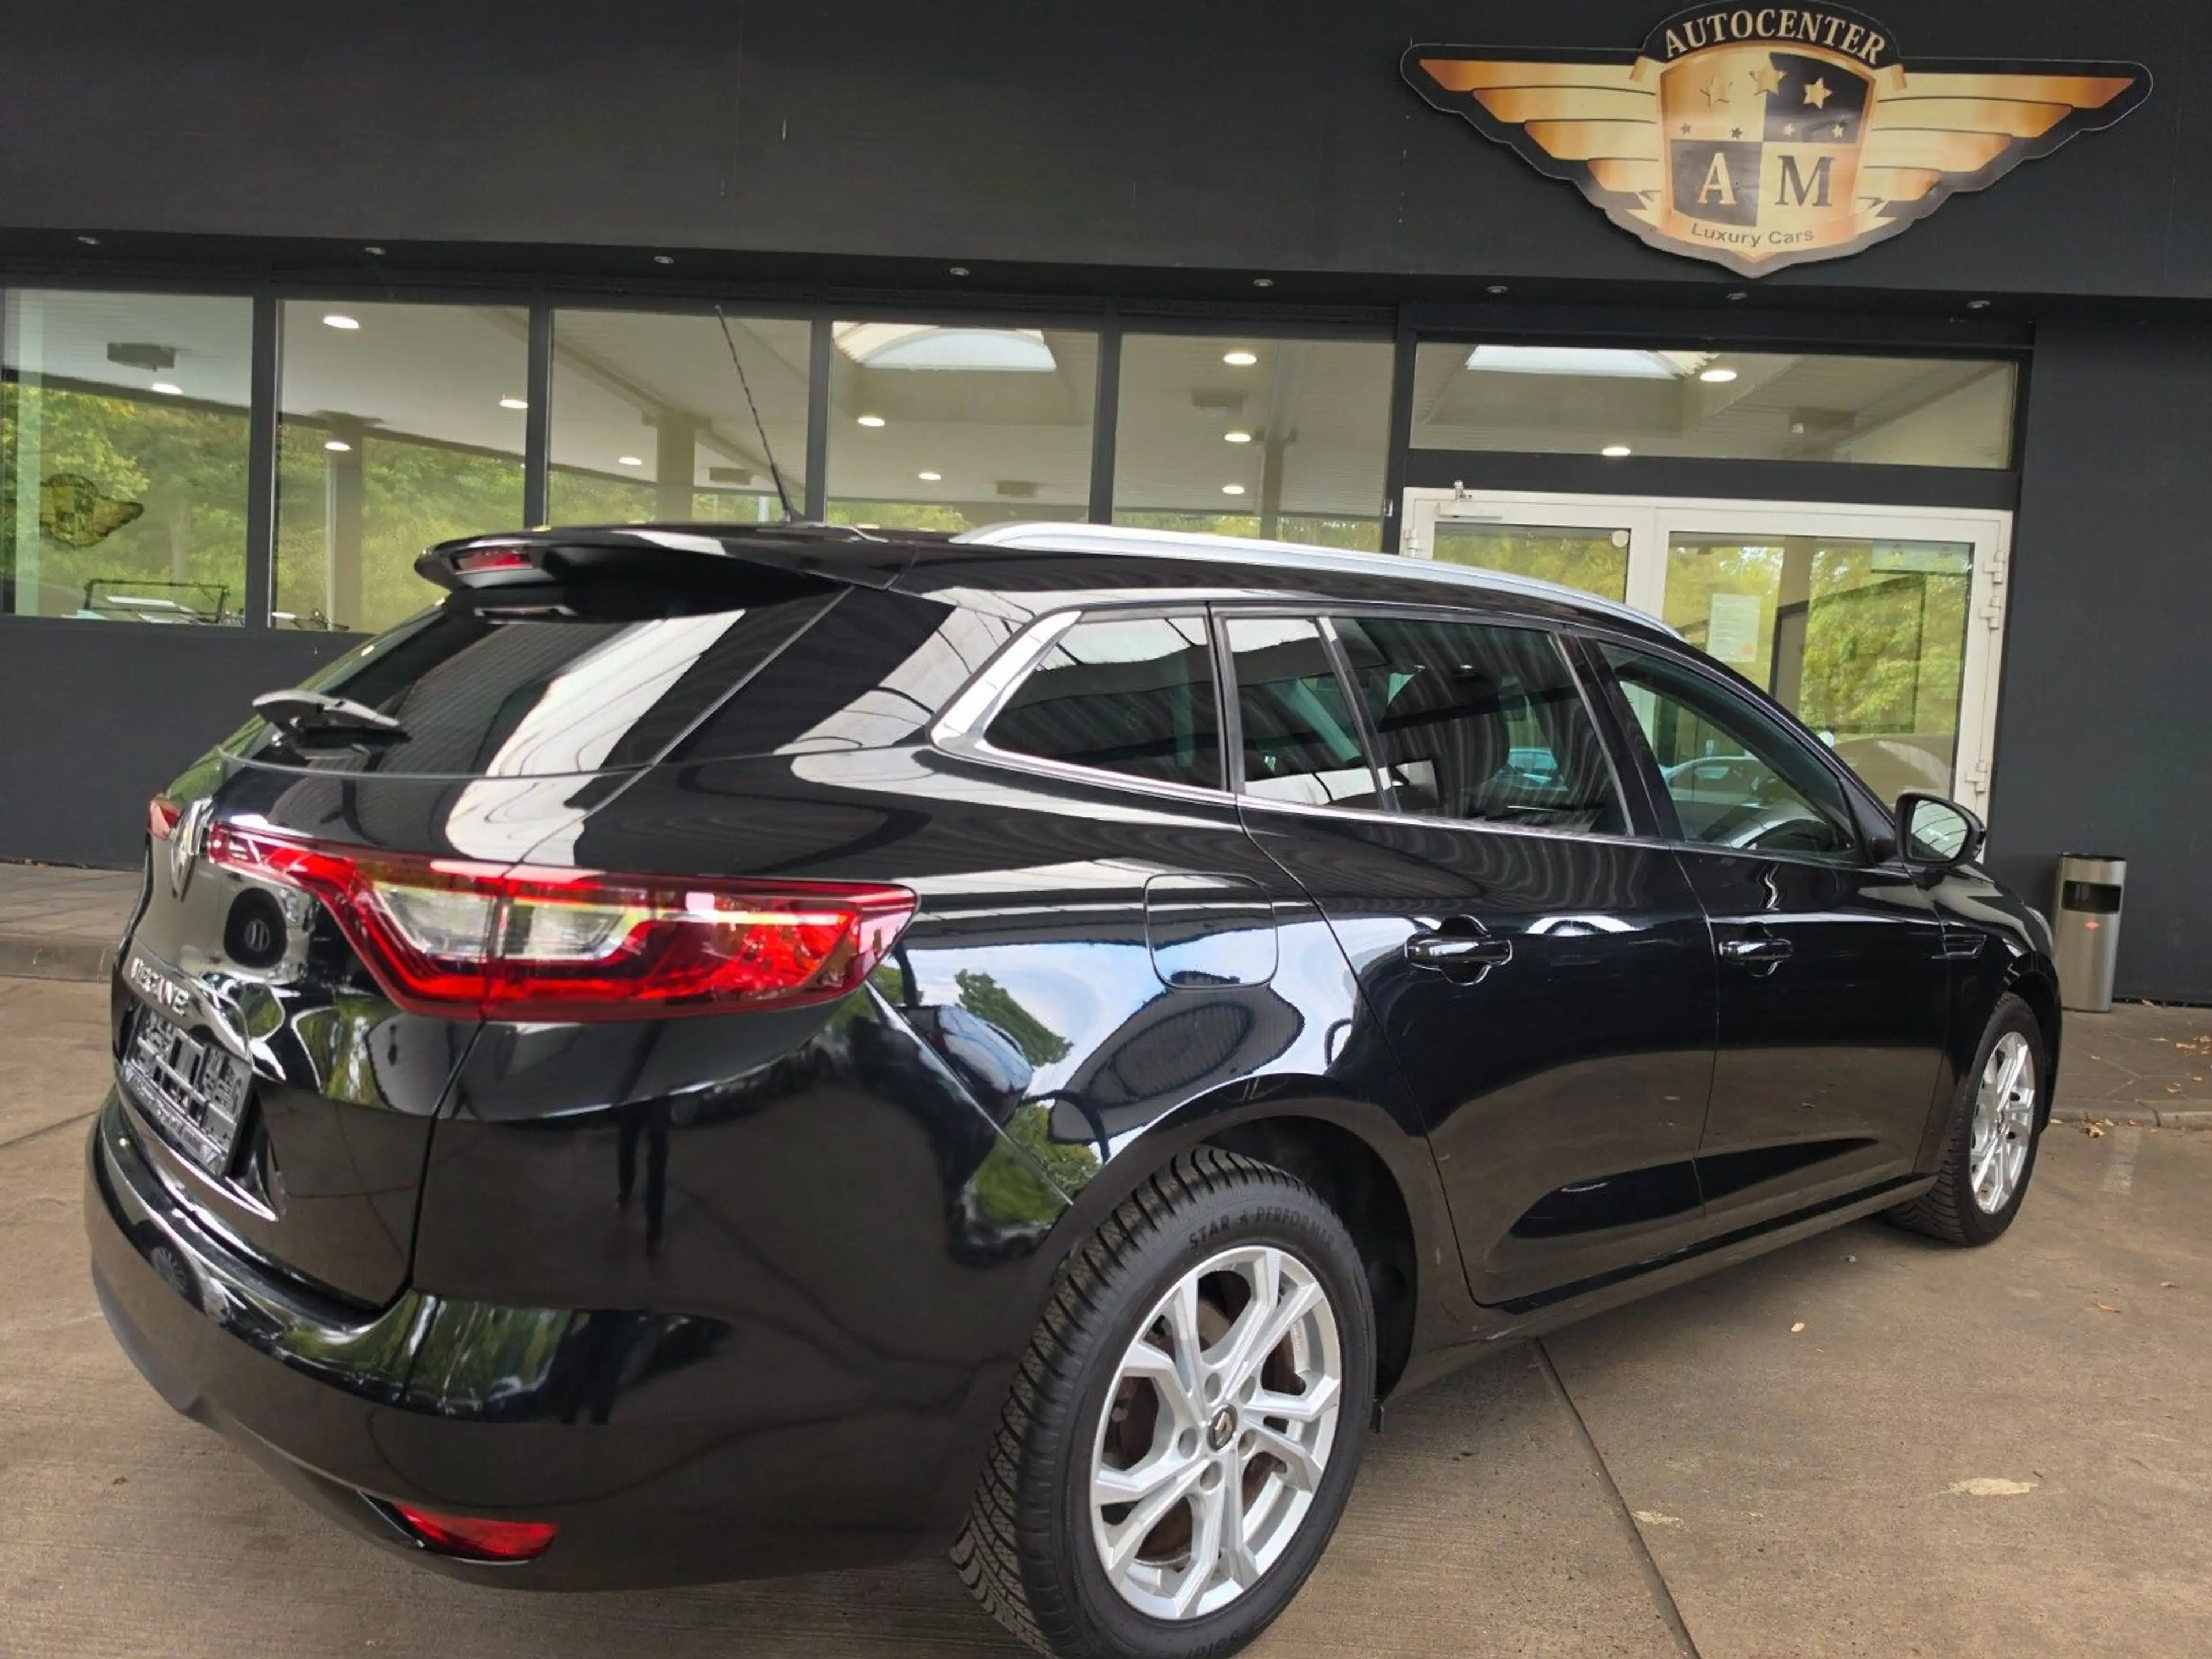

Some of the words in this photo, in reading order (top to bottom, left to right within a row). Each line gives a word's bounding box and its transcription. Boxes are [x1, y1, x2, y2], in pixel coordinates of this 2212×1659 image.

[1665, 9, 1885, 65] AUTOCENTER
[1697, 151, 1738, 206] A
[1774, 154, 1836, 207] M
[1691, 222, 1761, 247] Luxury
[1768, 230, 1814, 245] Cars
[1188, 1215, 1230, 1250] STAR
